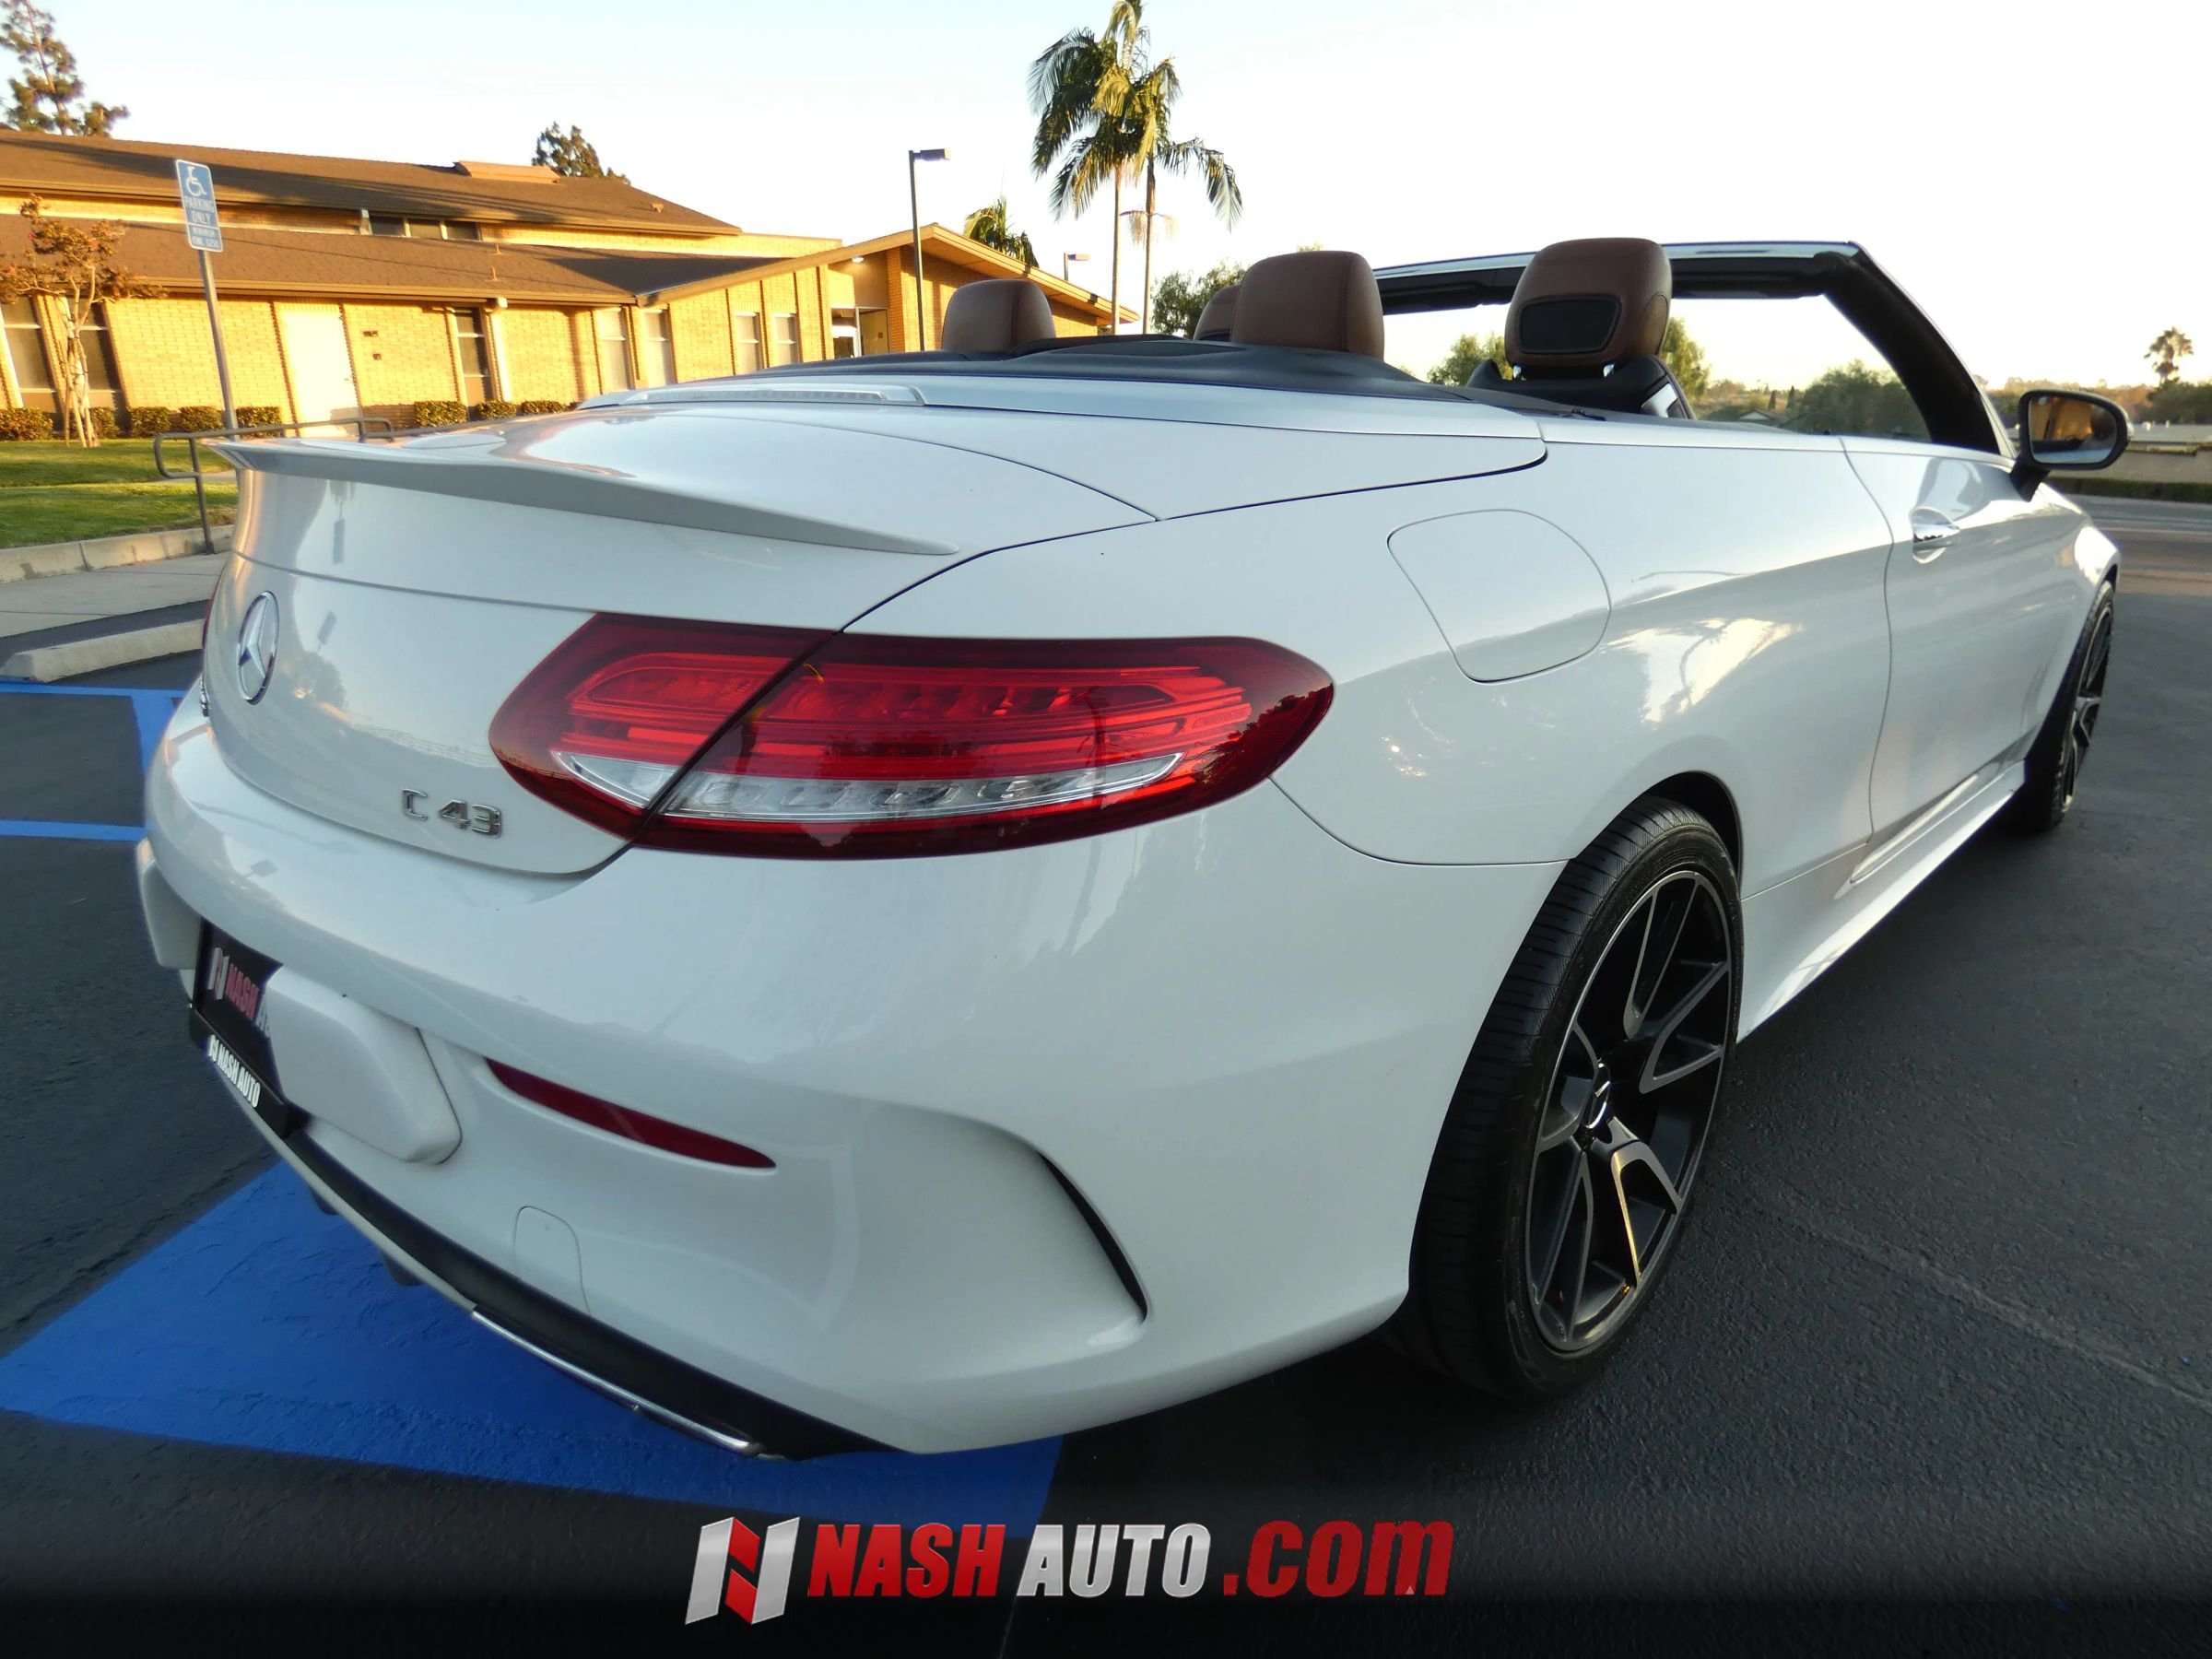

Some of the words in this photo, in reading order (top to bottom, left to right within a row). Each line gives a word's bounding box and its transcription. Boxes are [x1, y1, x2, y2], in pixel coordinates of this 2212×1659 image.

[184, 195, 216, 213] PARKING
[192, 210, 211, 225] ONLY
[402, 788, 429, 821] C
[437, 799, 502, 839] 43
[226, 962, 260, 1021] NASH
[218, 1043, 240, 1085] NASH
[237, 1066, 261, 1108] AUTO
